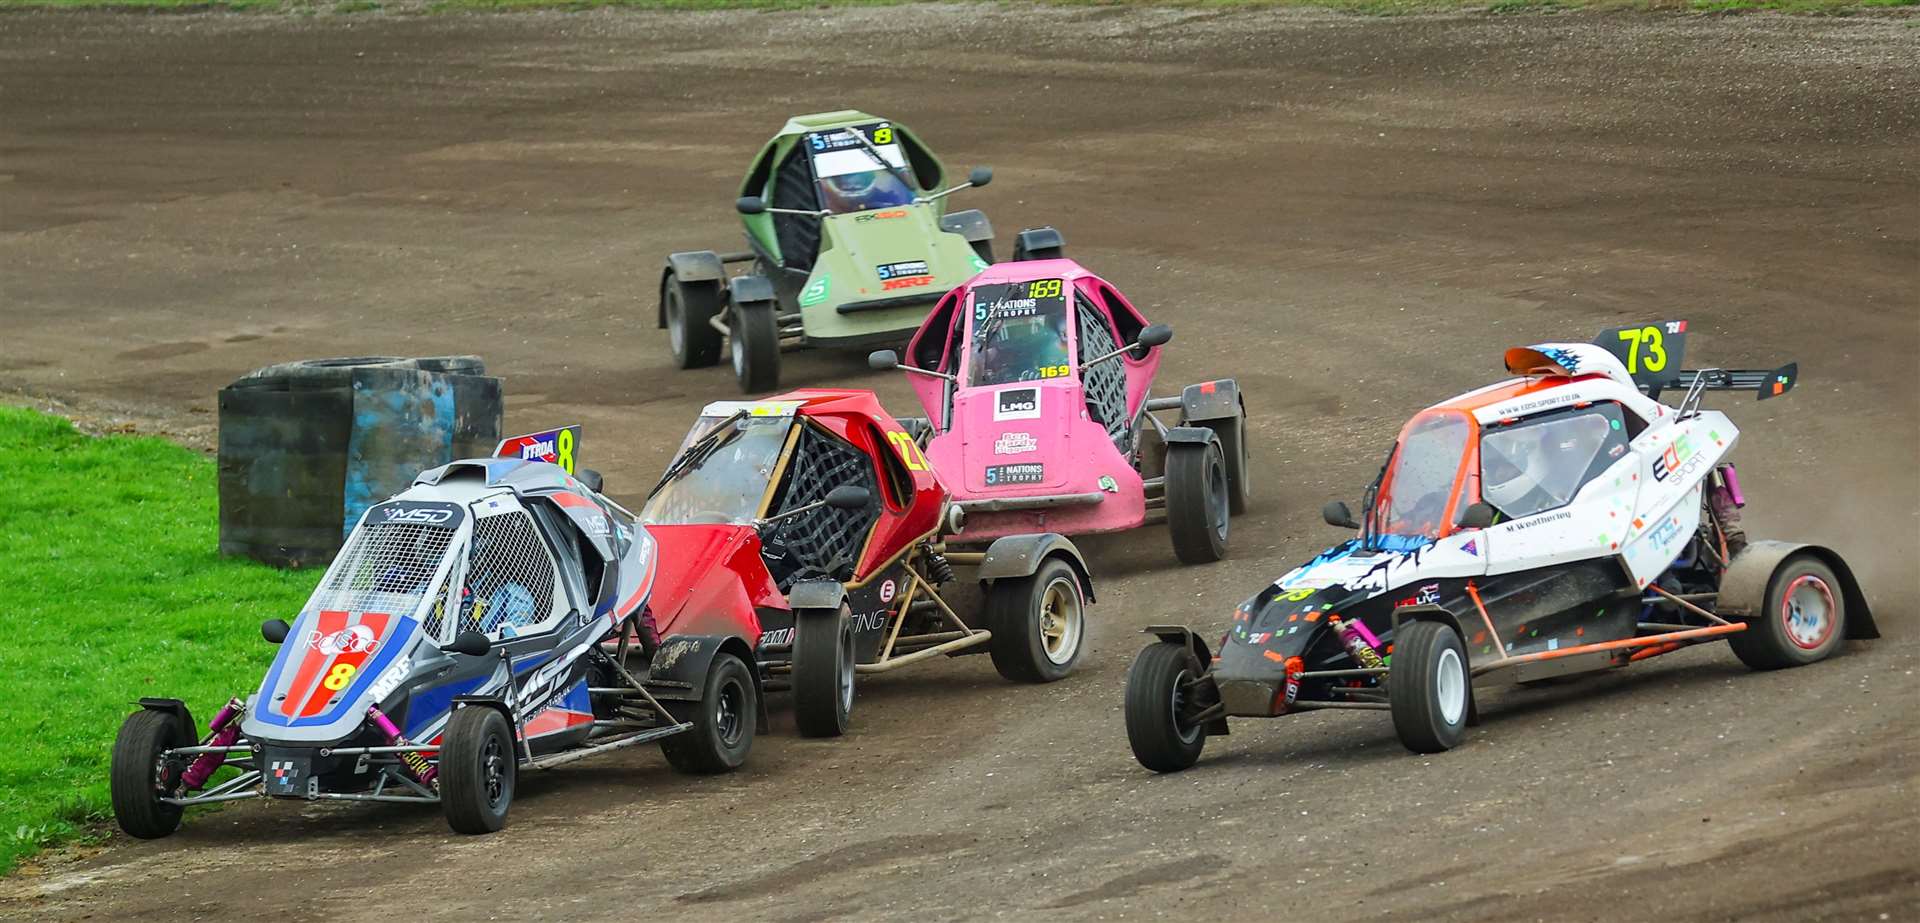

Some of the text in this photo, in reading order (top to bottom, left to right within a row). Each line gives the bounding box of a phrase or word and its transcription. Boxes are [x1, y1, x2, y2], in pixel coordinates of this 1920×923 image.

[809, 133, 826, 150] 5
[873, 127, 893, 144] 8
[878, 266, 890, 279] 5
[1028, 280, 1062, 299] 169
[975, 303, 987, 320] 5
[998, 308, 1037, 317] TROPHY
[1618, 326, 1668, 374] 73
[1040, 365, 1070, 378] 169
[1001, 402, 1034, 412] LMG
[523, 440, 554, 460] BTRDA
[558, 429, 574, 476] 8
[986, 468, 997, 483] 5
[1006, 465, 1042, 474] NATIONS
[1670, 449, 1706, 485] SPORT
[387, 508, 453, 523] MSD
[323, 663, 356, 691] 8
[368, 654, 410, 704] MRF
